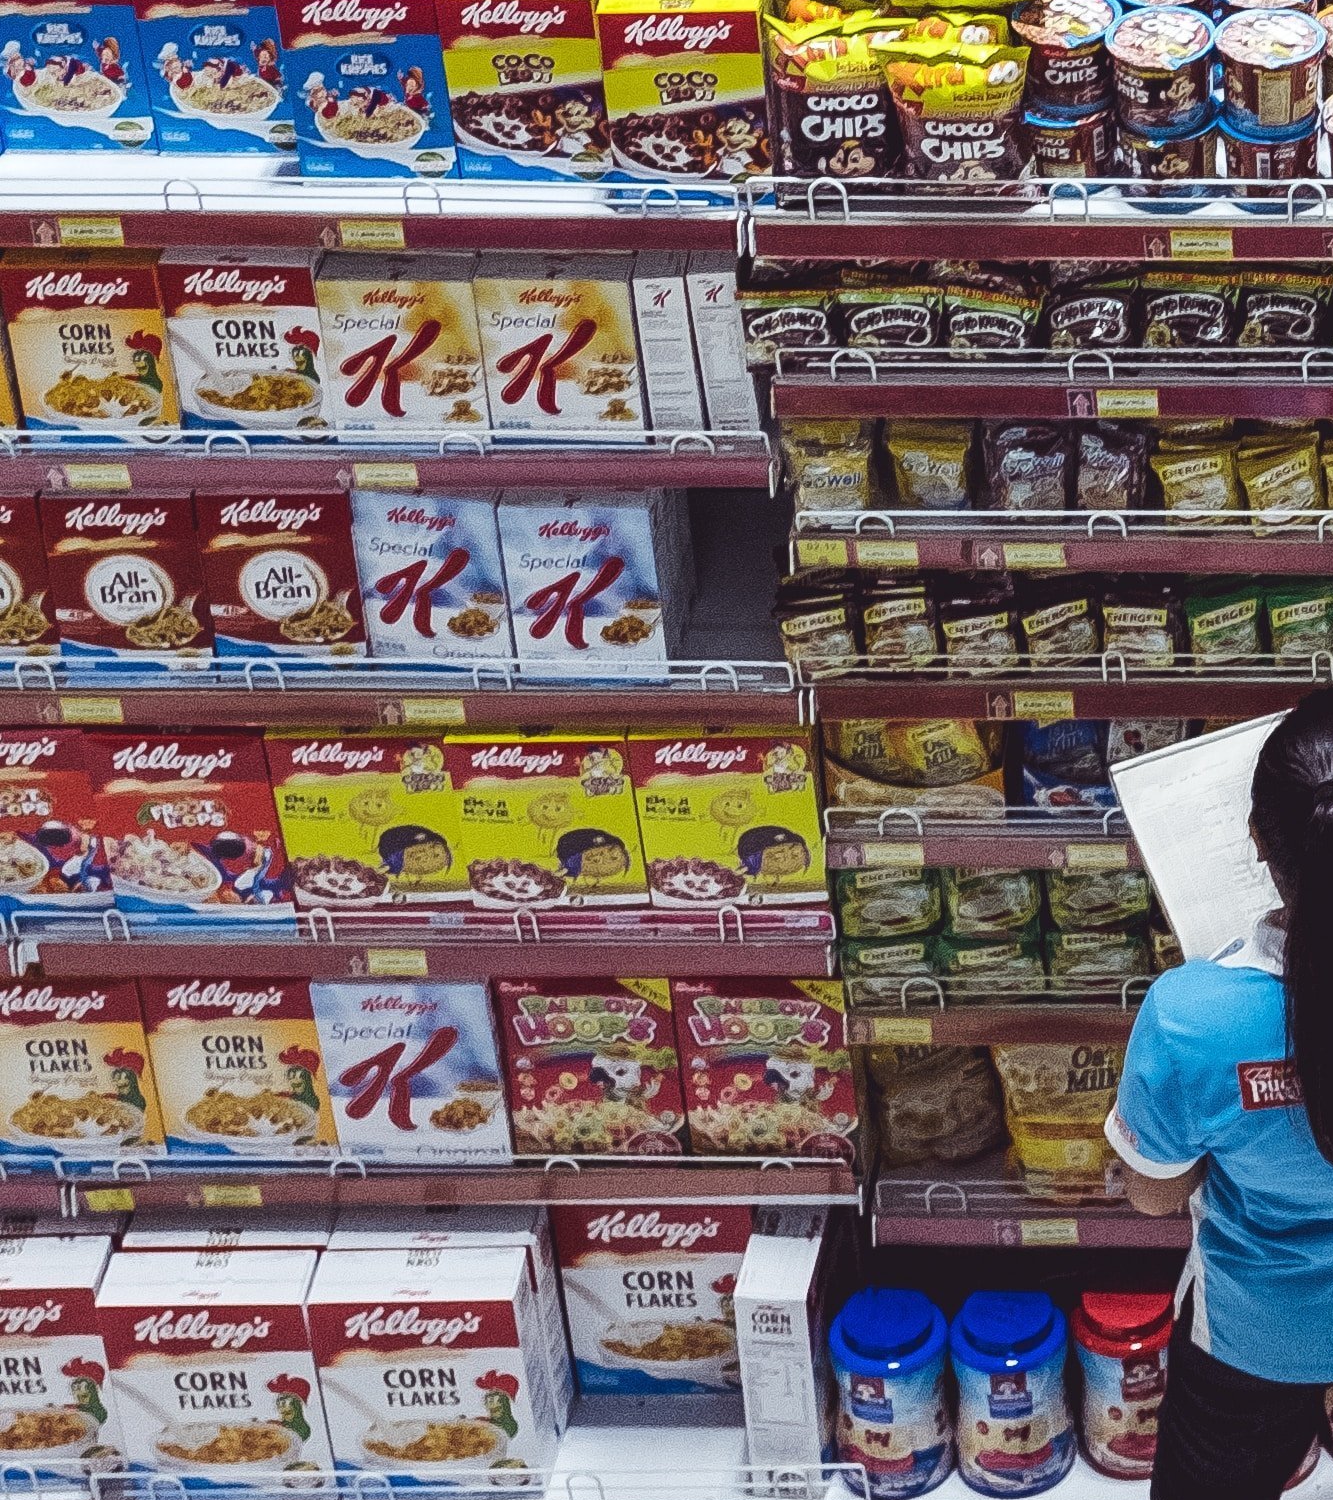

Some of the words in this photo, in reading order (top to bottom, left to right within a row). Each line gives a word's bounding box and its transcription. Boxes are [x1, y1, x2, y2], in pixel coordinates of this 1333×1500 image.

[461, 0, 567, 38] Kellogg's
[623, 14, 733, 49] Kellogg's
[492, 53, 555, 71] COCO
[1050, 57, 1093, 71] CHOCO
[653, 71, 718, 90] COCO
[1045, 68, 1098, 84] CHIPS
[807, 93, 879, 111] CHOCO
[800, 112, 886, 141] CHIPS
[924, 120, 994, 137] CHOCO
[920, 135, 1005, 162] CHIPS
[25, 272, 129, 305] Kellogg's
[184, 269, 288, 306] Kellogg's
[211, 319, 276, 340] CORN
[332, 314, 401, 335] Special
[488, 312, 557, 330] Special
[58, 323, 112, 341] CORN
[61, 341, 115, 356] FLAKES
[215, 341, 280, 359] FLAKES
[338, 319, 443, 417] K
[496, 319, 598, 415] K
[64, 503, 168, 535] Kellogg's
[220, 499, 323, 533] Kellogg's
[368, 537, 434, 557] Special
[519, 552, 587, 571] Special
[111, 570, 148, 590] All-
[266, 567, 303, 586] All-
[100, 585, 157, 604] Bran
[254, 580, 311, 599] Bran
[375, 548, 470, 638] K
[525, 556, 624, 650] K
[113, 742, 234, 778] Kellogg's
[330, 1024, 412, 1042] Special
[25, 1039, 88, 1057] CORN
[338, 1026, 459, 1131] K
[587, 1211, 722, 1246] Kellogg's
[622, 1270, 694, 1291] CORN
[625, 1291, 697, 1309] FLAKES
[173, 1371, 247, 1392] CORN
[383, 1369, 457, 1390] CORN
[178, 1393, 253, 1410] FLAKES
[387, 1390, 461, 1408] FLAKES
